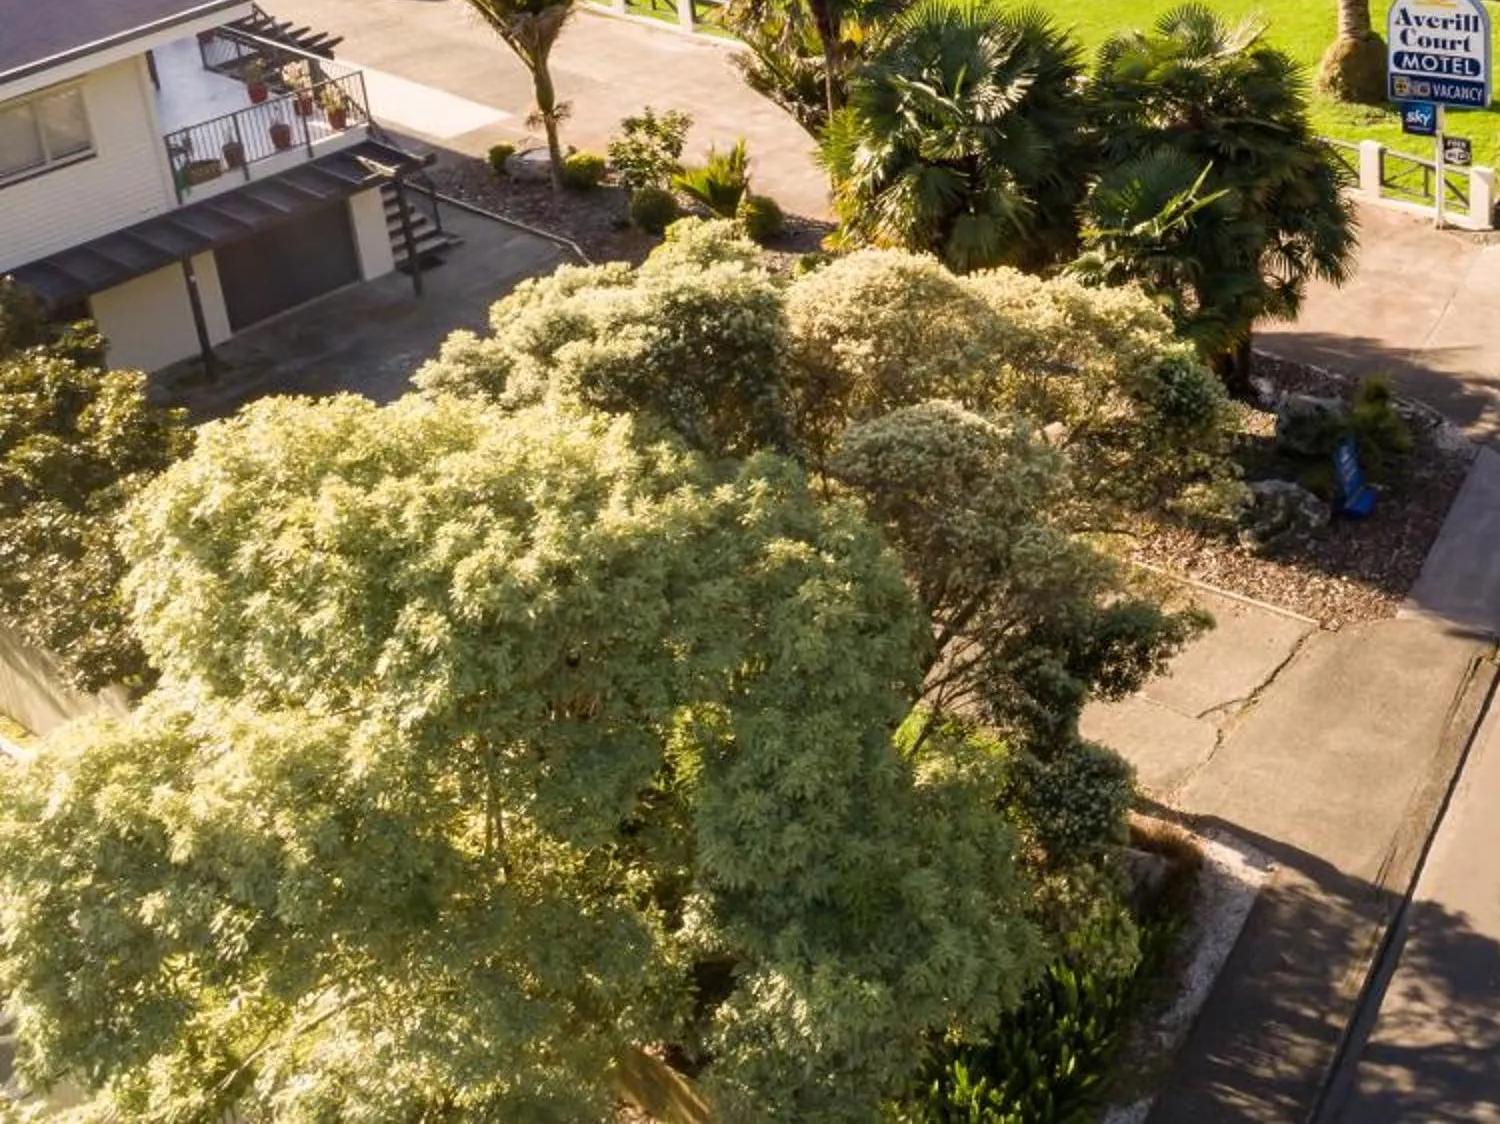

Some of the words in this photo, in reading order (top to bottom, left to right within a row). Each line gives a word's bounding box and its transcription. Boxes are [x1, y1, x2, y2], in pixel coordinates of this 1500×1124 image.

[1395, 7, 1479, 33] Averill
[1399, 27, 1472, 53] Court
[1401, 54, 1475, 75] MOTEL
[1433, 83, 1483, 101] VACANCY
[1406, 109, 1432, 126] sky
